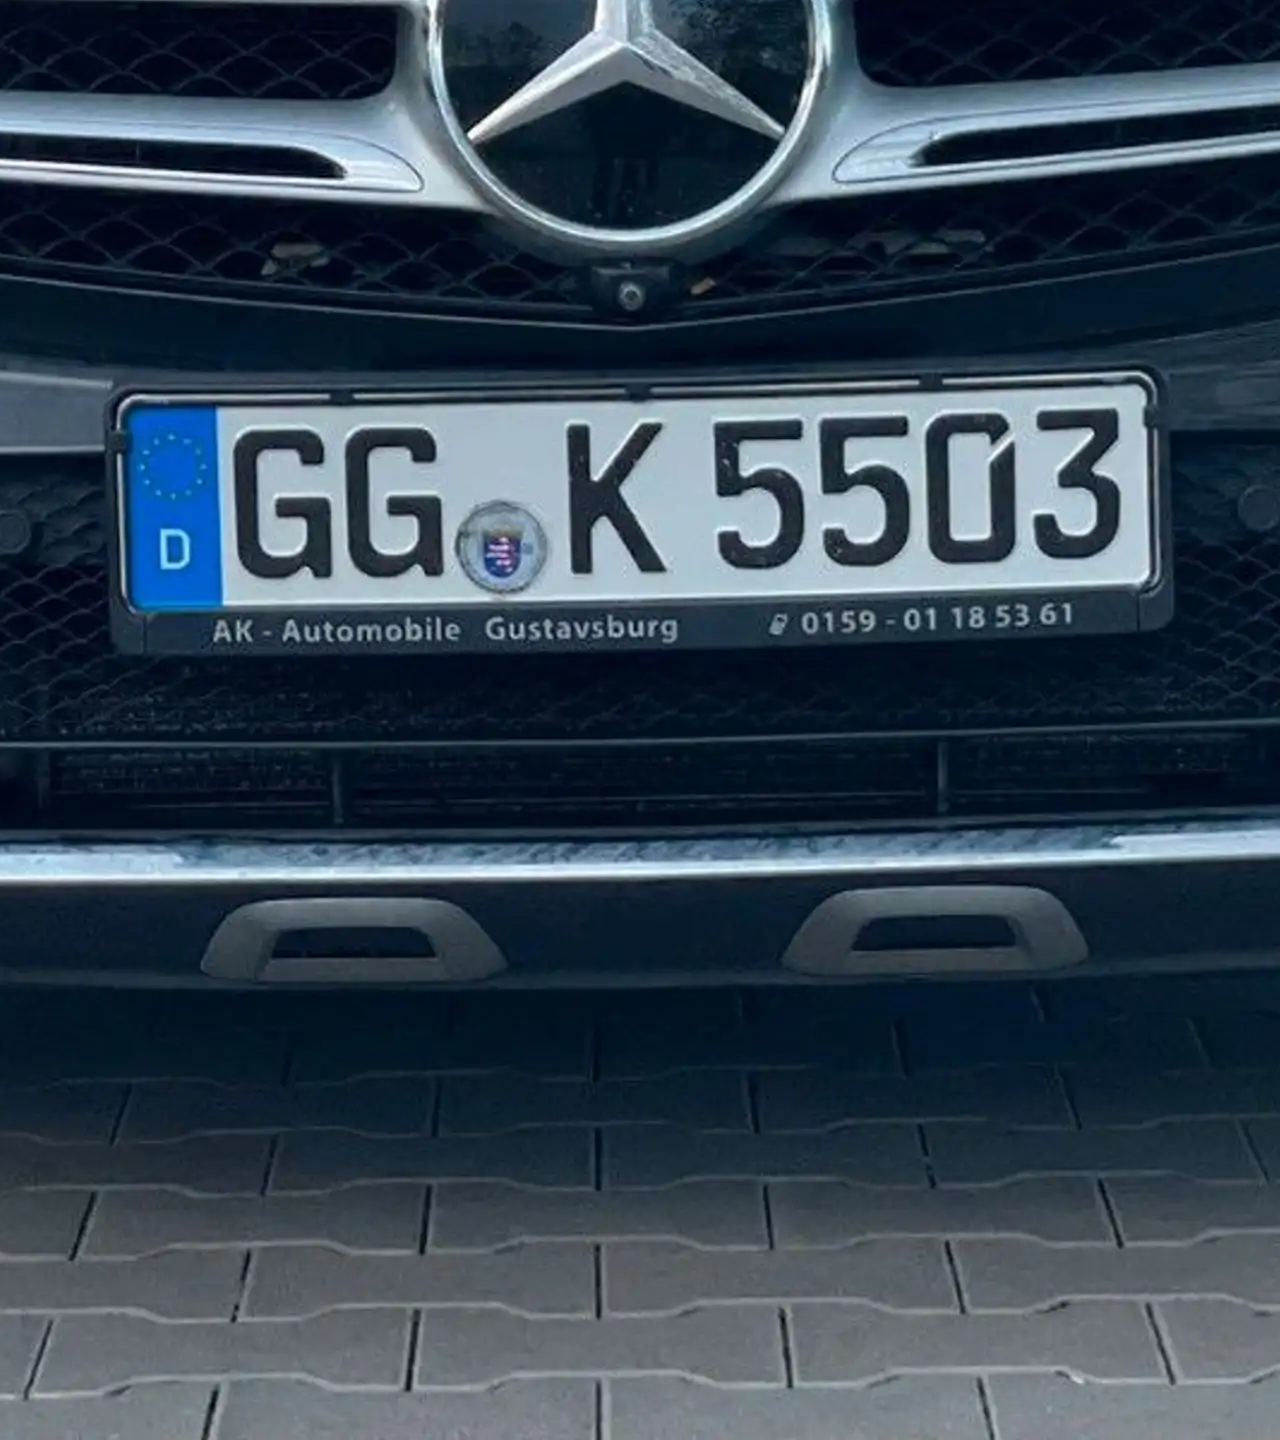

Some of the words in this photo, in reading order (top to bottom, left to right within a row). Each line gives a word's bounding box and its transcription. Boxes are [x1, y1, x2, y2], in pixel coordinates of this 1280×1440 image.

[232, 428, 445, 580] GG
[565, 421, 668, 575] K
[713, 407, 1122, 569] 5503
[158, 527, 192, 571] D
[212, 619, 253, 643] AK
[281, 616, 462, 643] Automobile
[484, 614, 679, 644] Gustavsburg
[801, 609, 877, 634] 0159
[903, 607, 937, 631] 01
[951, 606, 985, 629] 18
[995, 604, 1031, 628] 53
[1039, 602, 1073, 626] 61
